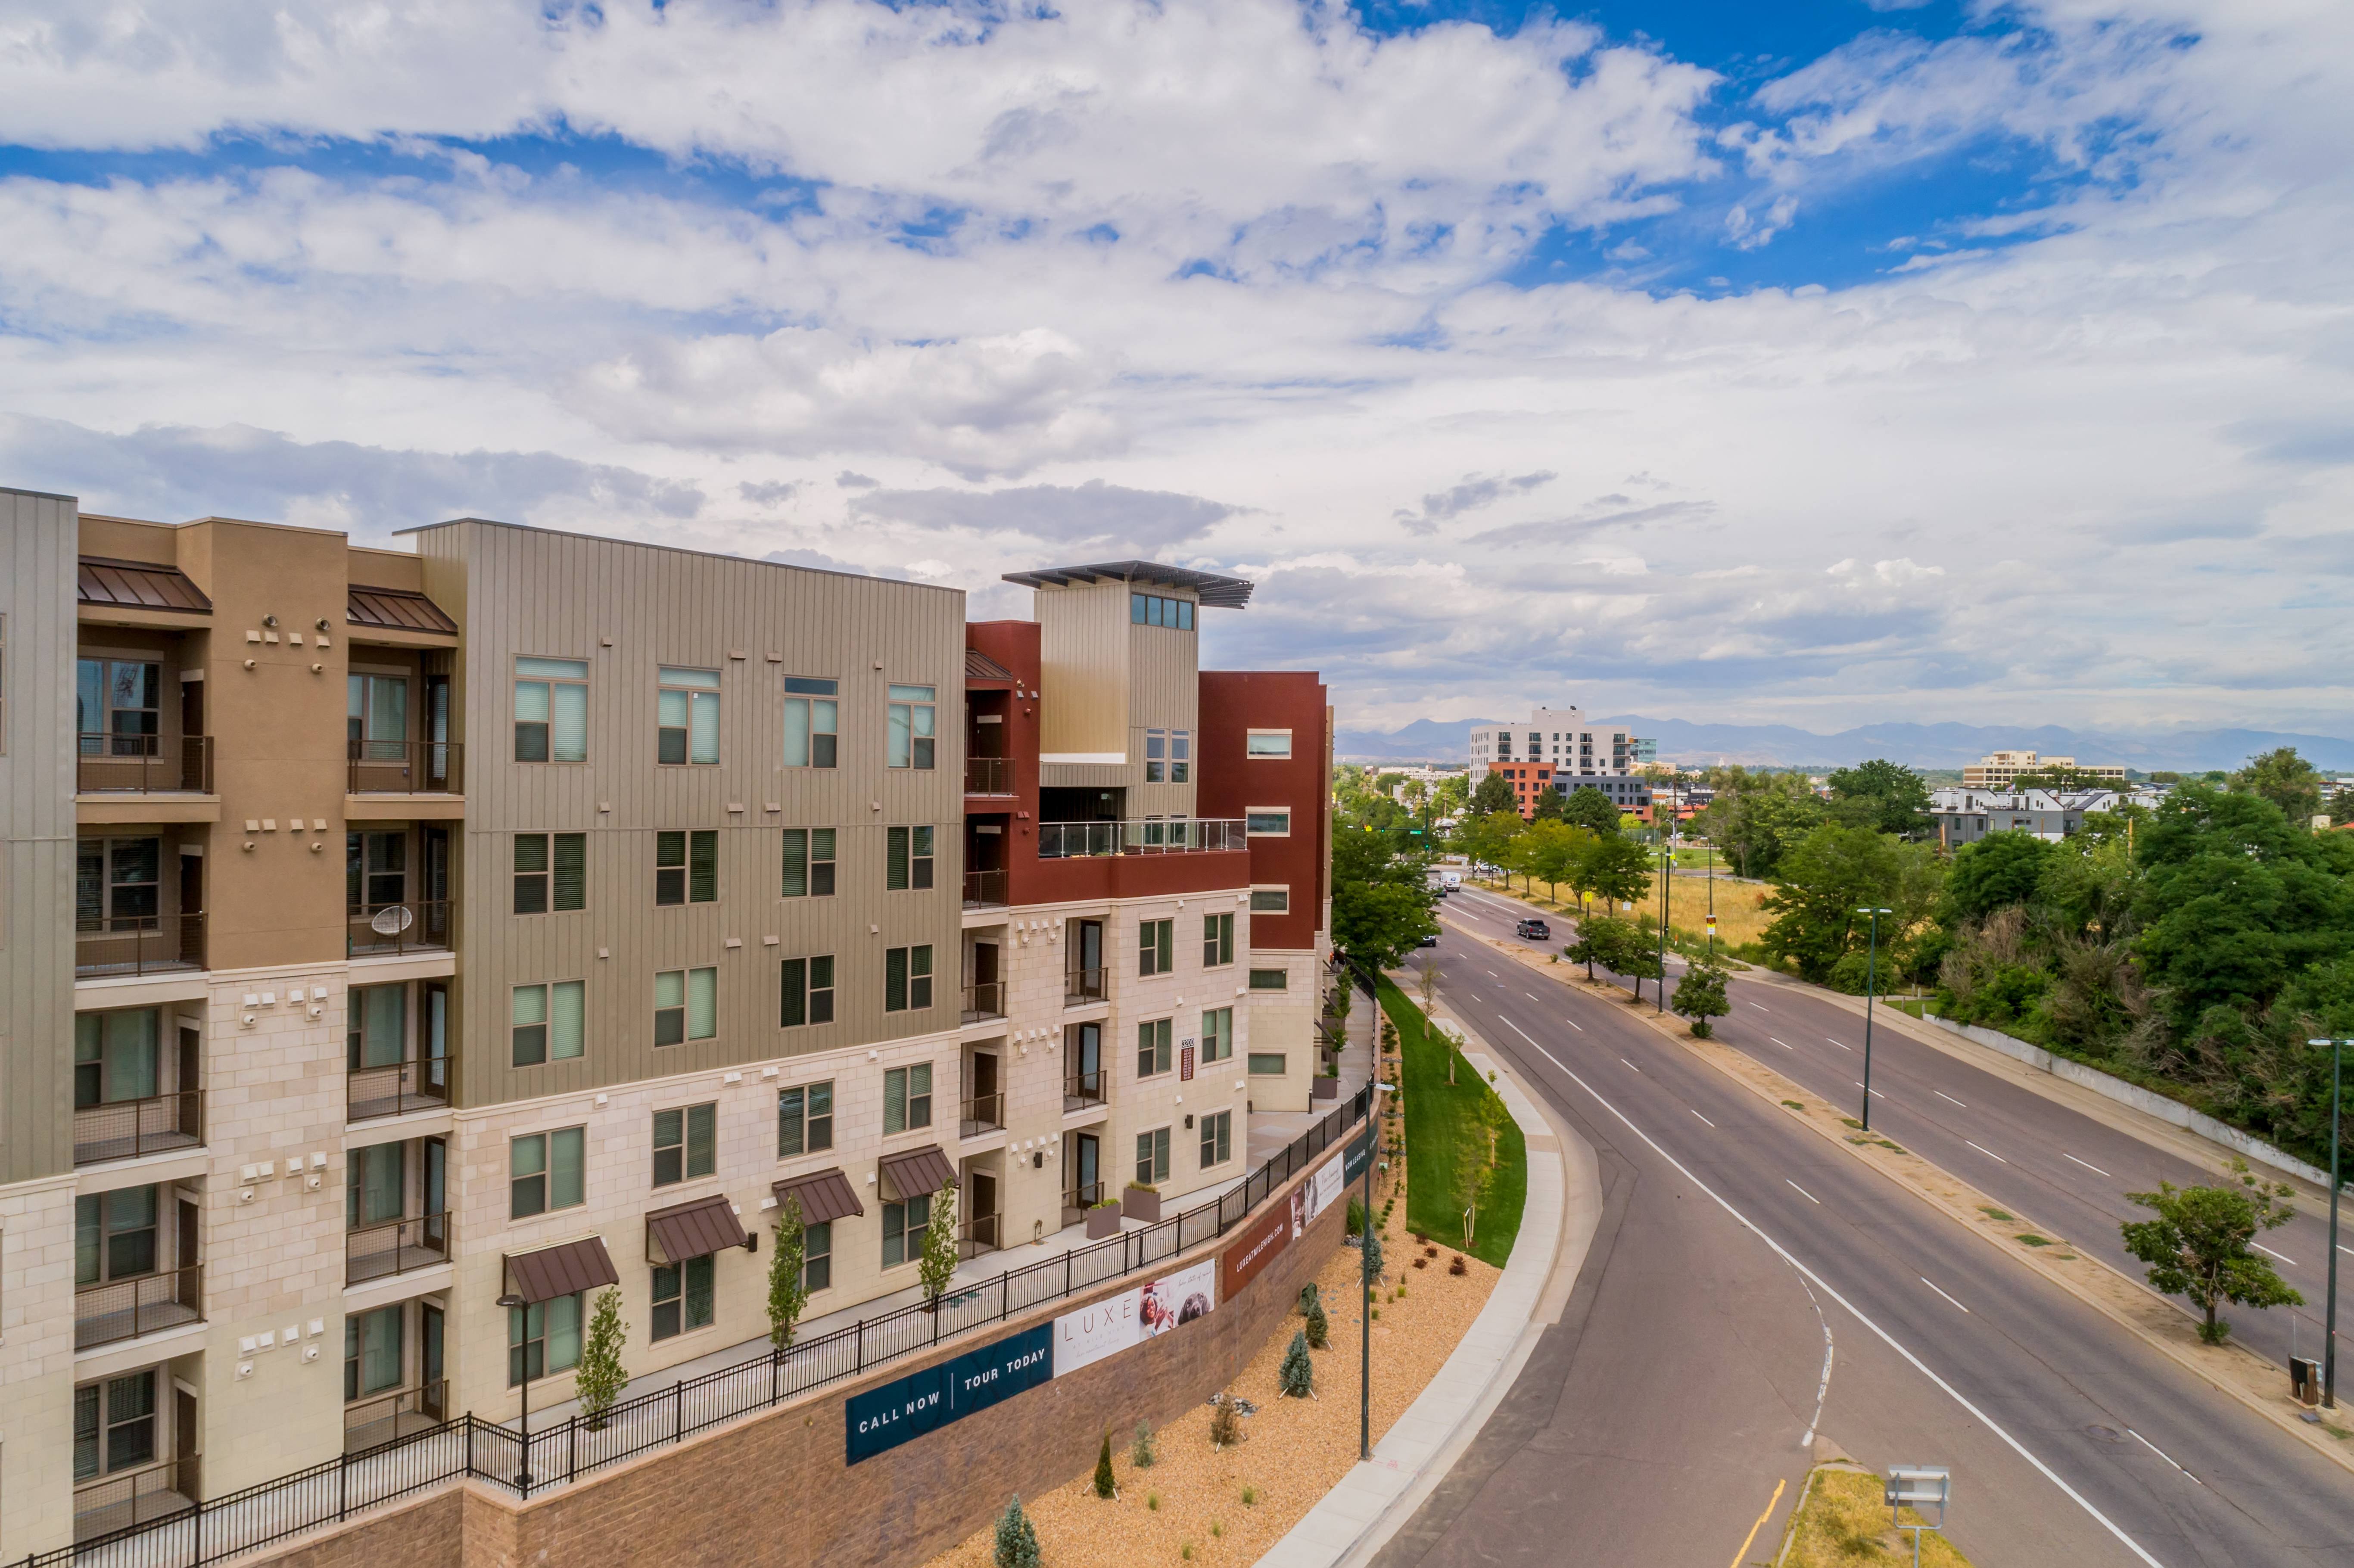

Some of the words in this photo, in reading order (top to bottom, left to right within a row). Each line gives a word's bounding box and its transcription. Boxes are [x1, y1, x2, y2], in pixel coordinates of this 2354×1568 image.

[1182, 1039, 1194, 1047] 3200
[1352, 1149, 1365, 1165] LEASING
[1236, 1223, 1283, 1272] LUXEATMILEHIGH.COM
[1065, 1299, 1131, 1341] LUXE
[859, 1409, 899, 1433] CALL
[906, 1391, 939, 1415] NOW
[965, 1368, 998, 1391] TOUR
[1006, 1348, 1045, 1373] TODAY
